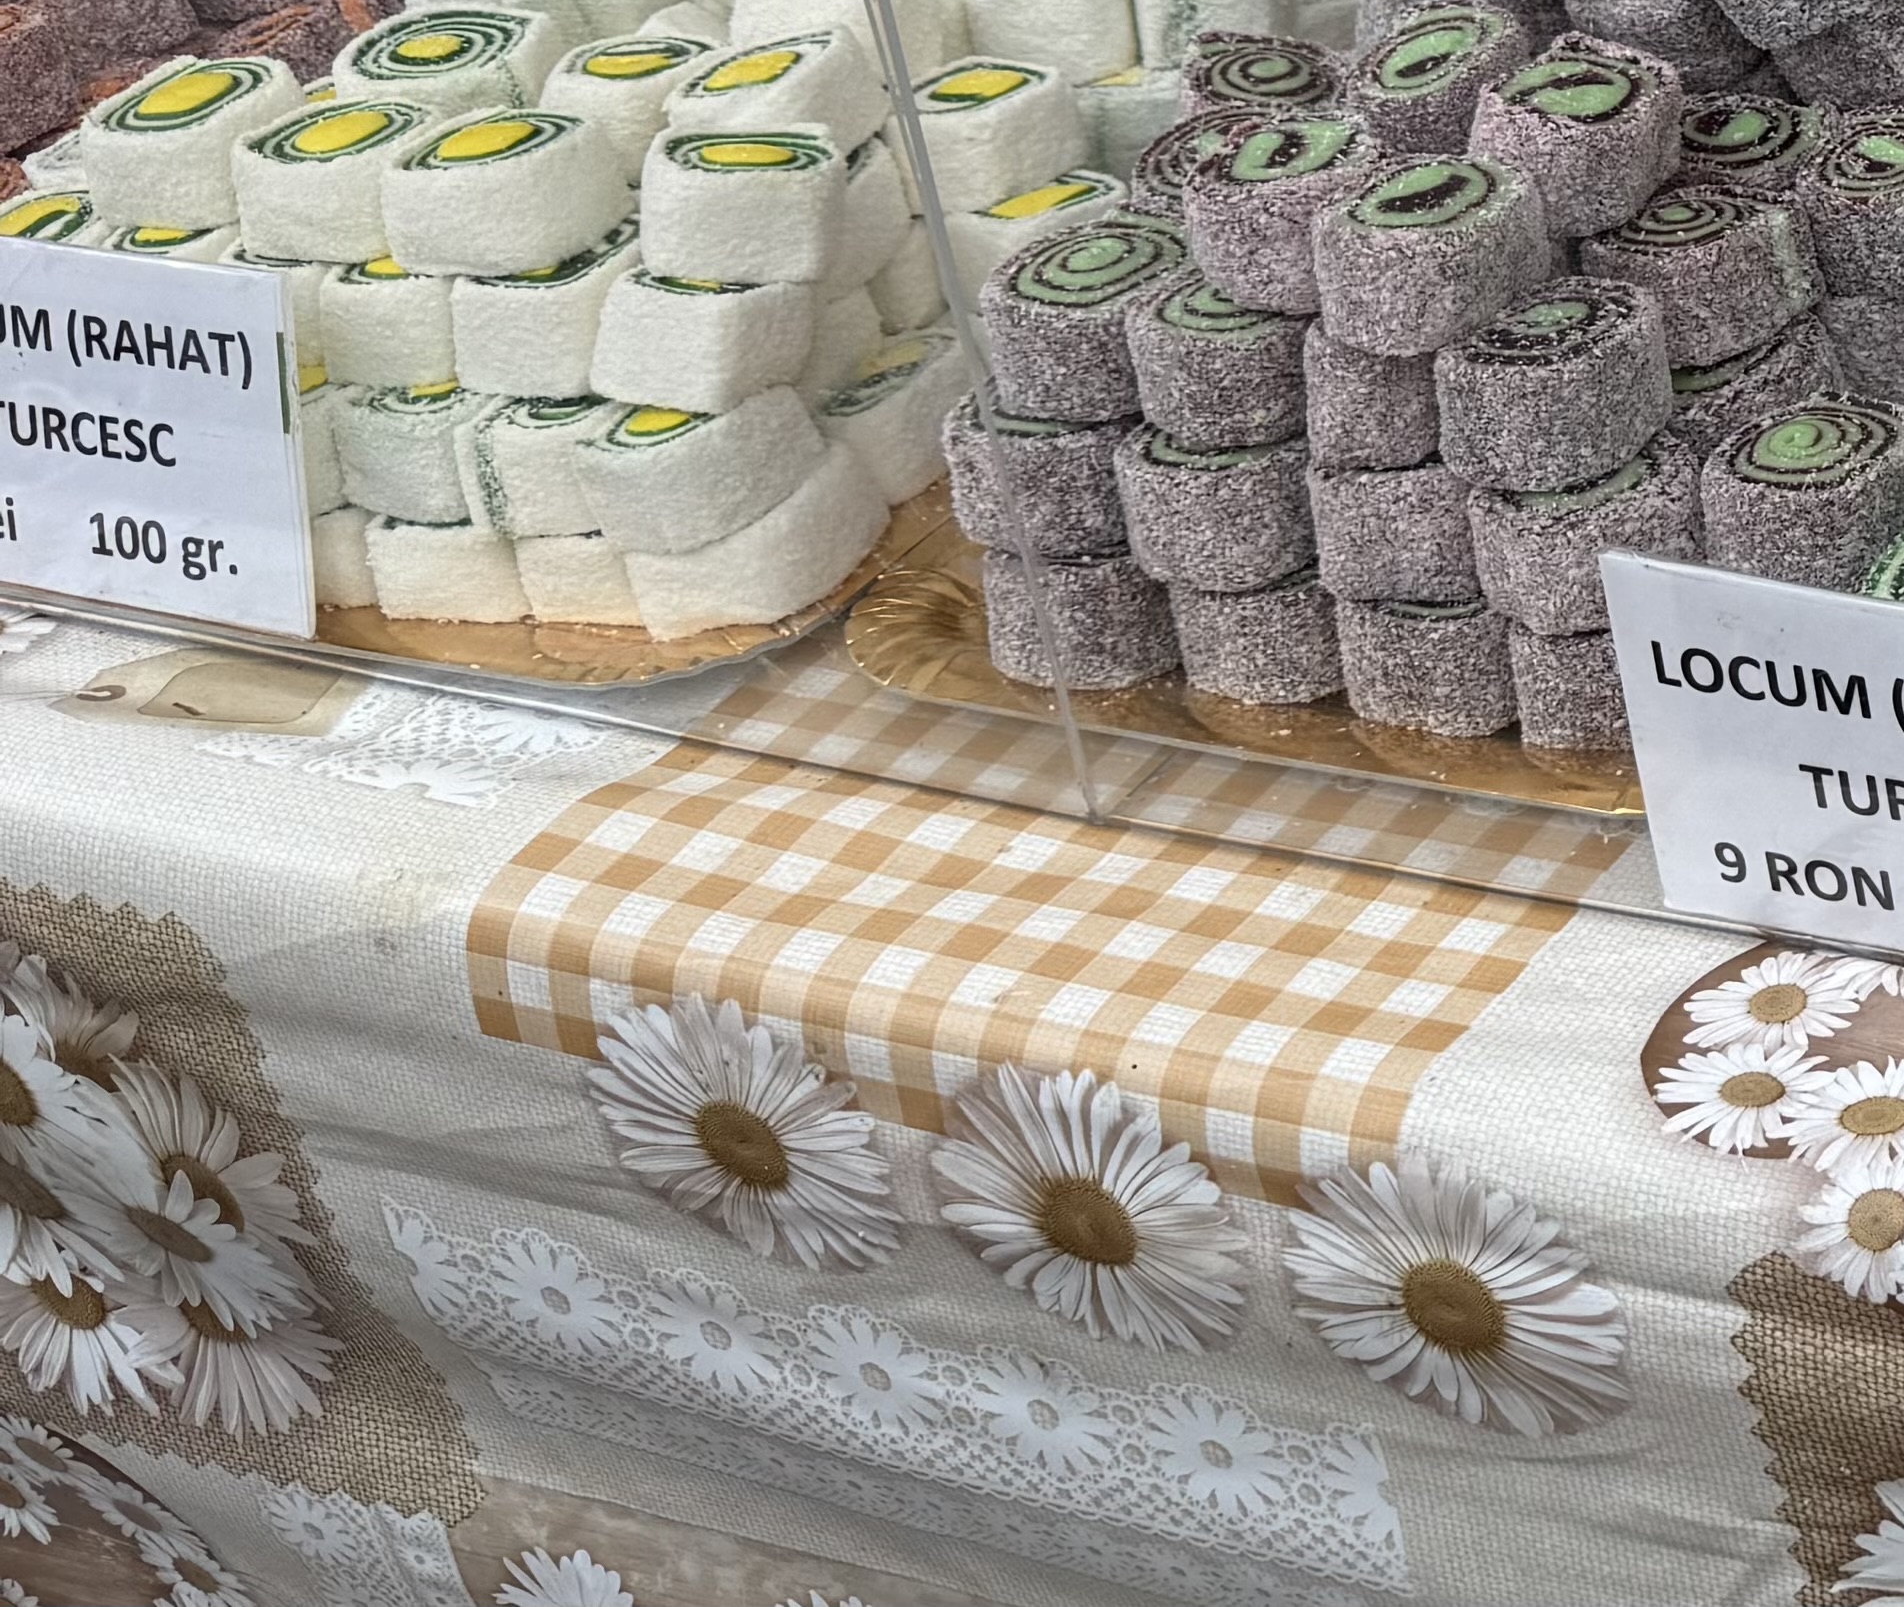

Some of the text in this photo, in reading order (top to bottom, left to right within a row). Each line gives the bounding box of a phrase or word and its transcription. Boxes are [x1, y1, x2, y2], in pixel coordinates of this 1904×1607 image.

[0, 304, 251, 389] M (RAHAT)
[90, 513, 237, 580] 100 gr.
[1651, 641, 1871, 719] LOCUM
[1715, 843, 1746, 882] 9
[1766, 852, 1894, 910] RON
